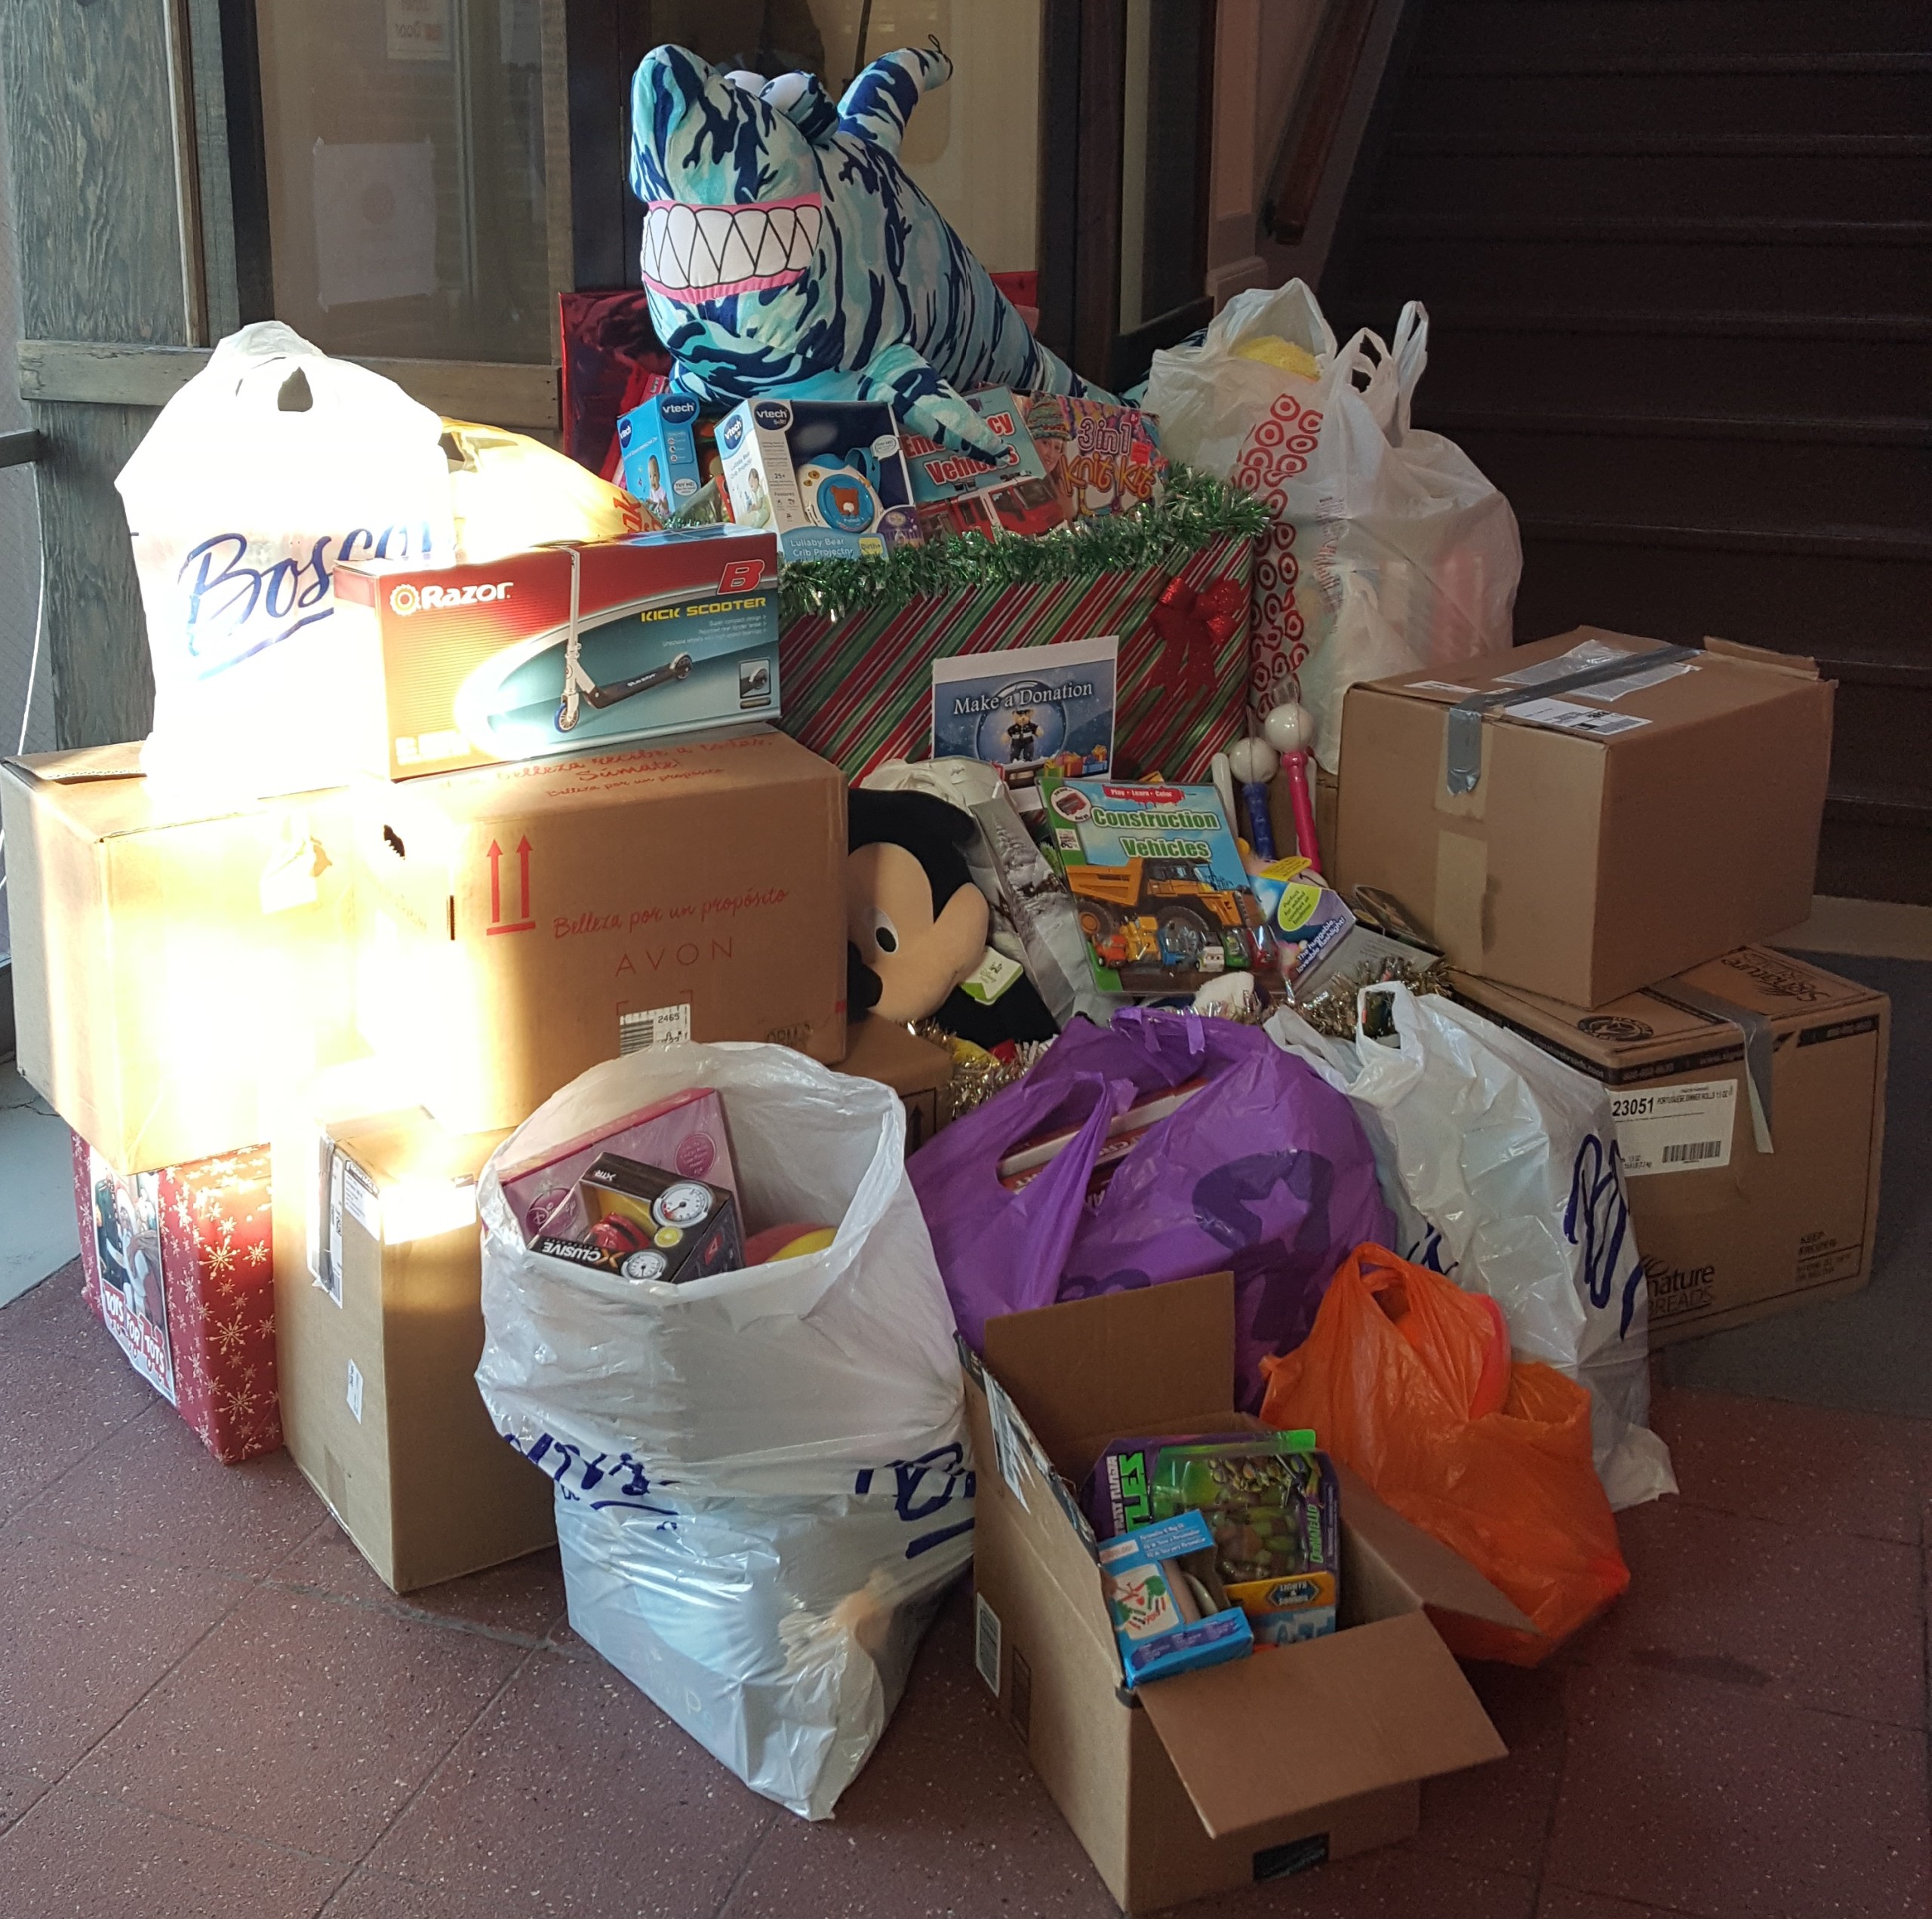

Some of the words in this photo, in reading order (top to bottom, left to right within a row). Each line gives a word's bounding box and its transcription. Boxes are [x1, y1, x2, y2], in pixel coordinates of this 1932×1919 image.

[662, 402, 695, 414] vtech
[757, 407, 788, 419] vtech
[724, 420, 743, 439] vtech
[1062, 453, 1115, 497] Knit
[1118, 457, 1155, 500] Kit
[790, 538, 823, 549] Lullaby
[825, 537, 844, 546] Bear
[792, 547, 813, 557] Crib
[717, 558, 765, 595] B
[641, 608, 680, 623] KICK
[686, 597, 767, 617] SCOOTER
[953, 695, 1000, 715] Make
[1004, 697, 1014, 708] a
[1020, 682, 1093, 706] Donation
[1110, 789, 1125, 797] Play
[1131, 789, 1150, 797] Learn
[1091, 808, 1220, 830] Construction
[1119, 837, 1213, 859] Vehicles
[554, 909, 622, 939] Belleza
[629, 908, 663, 933] por
[669, 902, 696, 920] un
[700, 887, 791, 922] propósito
[1297, 949, 1309, 961] The
[1306, 918, 1337, 952] huggable,
[1297, 946, 1320, 974] loveable
[1319, 916, 1346, 949] flashlight!
[616, 936, 733, 977] AVON
[657, 1012, 681, 1024] 2465
[1612, 1097, 1654, 1117] 23051
[594, 1170, 617, 1182] XTR
[1648, 1285, 1714, 1318] READS
[104, 1288, 125, 1324] TOYS
[126, 1313, 140, 1350] FOR
[144, 1335, 165, 1374] TOTS
